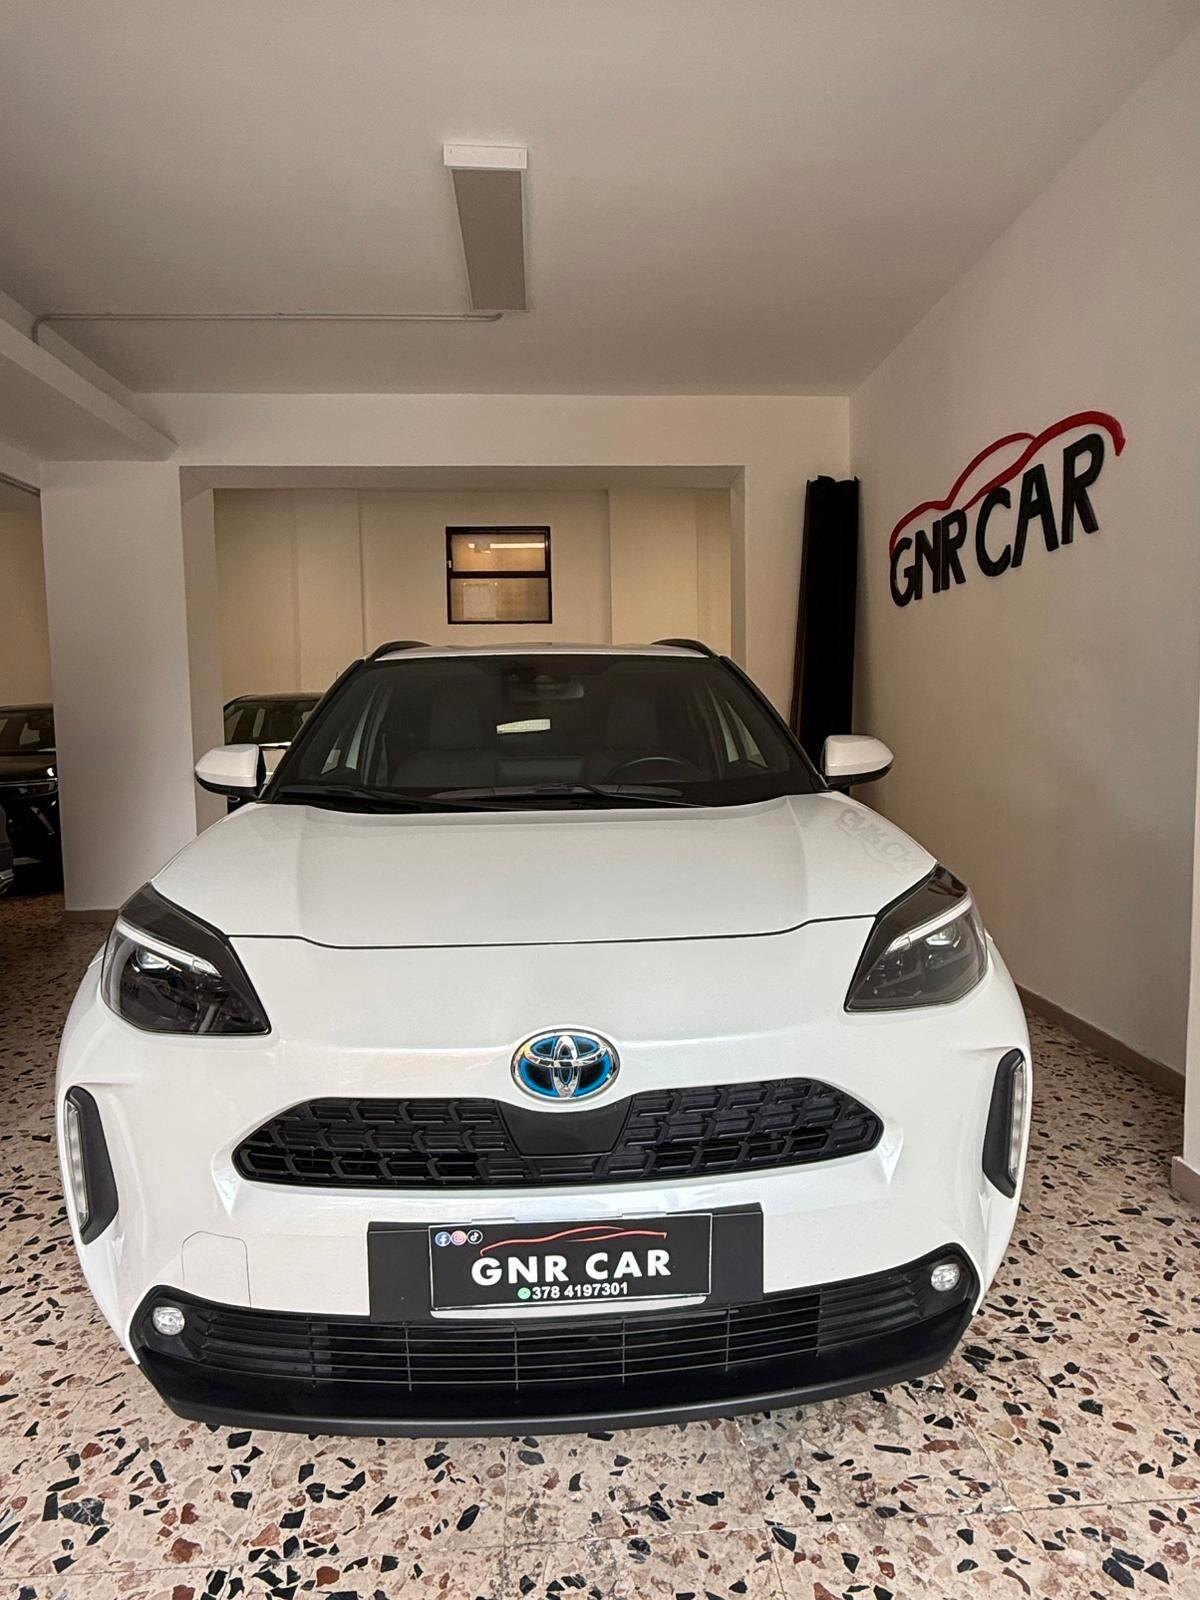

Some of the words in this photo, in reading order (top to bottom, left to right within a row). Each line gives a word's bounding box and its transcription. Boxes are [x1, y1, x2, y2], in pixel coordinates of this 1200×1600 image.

[890, 509, 968, 607] GNR
[975, 433, 1105, 577] CAR
[471, 1255, 569, 1286] GNR
[585, 1249, 671, 1280] CAR
[532, 1286, 560, 1299] 378
[564, 1282, 628, 1298] 4197301
